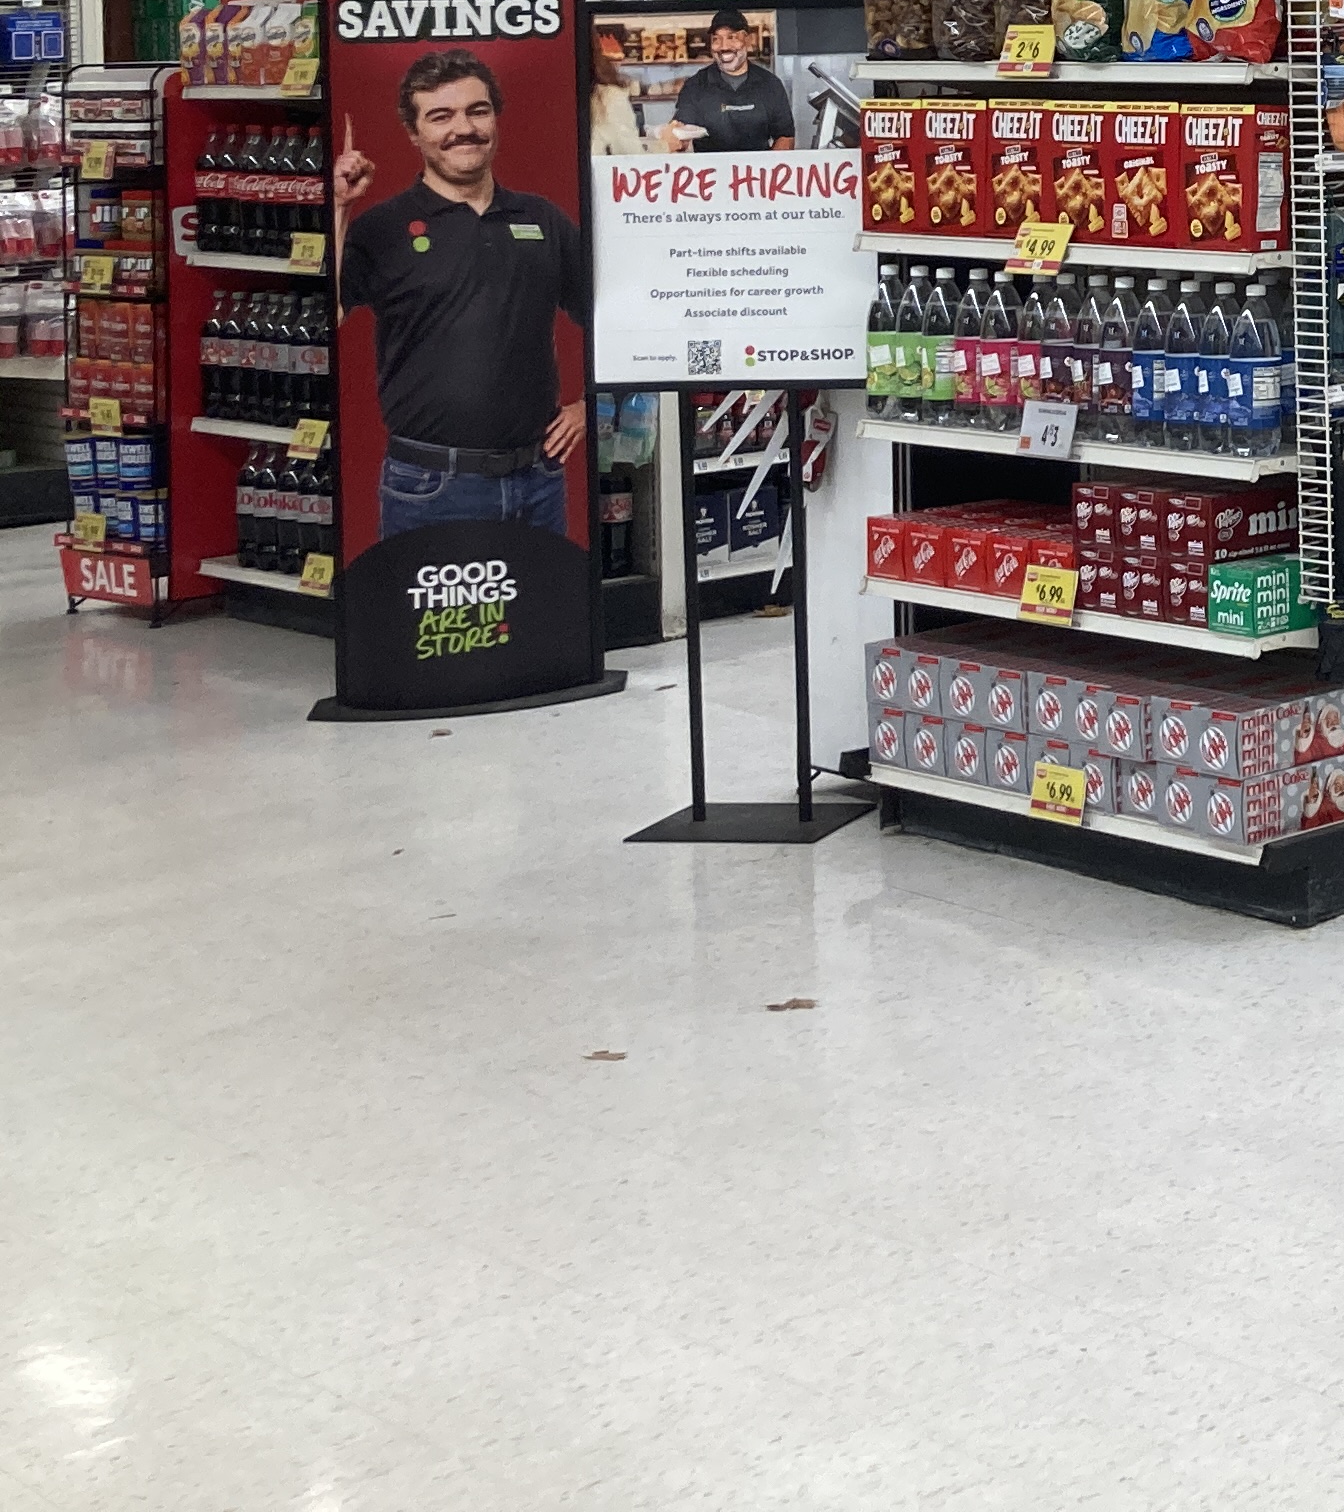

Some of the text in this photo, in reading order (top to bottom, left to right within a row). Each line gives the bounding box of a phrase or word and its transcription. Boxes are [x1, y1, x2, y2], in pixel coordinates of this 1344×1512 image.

[875, 150, 901, 163] TOASTY
[935, 152, 963, 164] TOASTY
[612, 161, 858, 203] WE'RE HIRING
[623, 212, 672, 224] There's
[676, 211, 722, 225] always
[725, 212, 761, 222] room
[765, 211, 778, 221] at
[781, 211, 805, 220] our
[669, 245, 807, 258] Part-time shifts available
[687, 266, 789, 279] Flexible scheduling
[650, 285, 824, 300] Opportunities for career growth
[685, 306, 787, 318] Associate discount
[81, 558, 138, 597] SALE
[417, 560, 508, 587] GOOD
[1257, 569, 1289, 589] mini
[408, 579, 517, 610] THINGS
[1211, 580, 1250, 603] Sprite
[419, 598, 505, 636] ARE IN
[1218, 610, 1243, 626] mini
